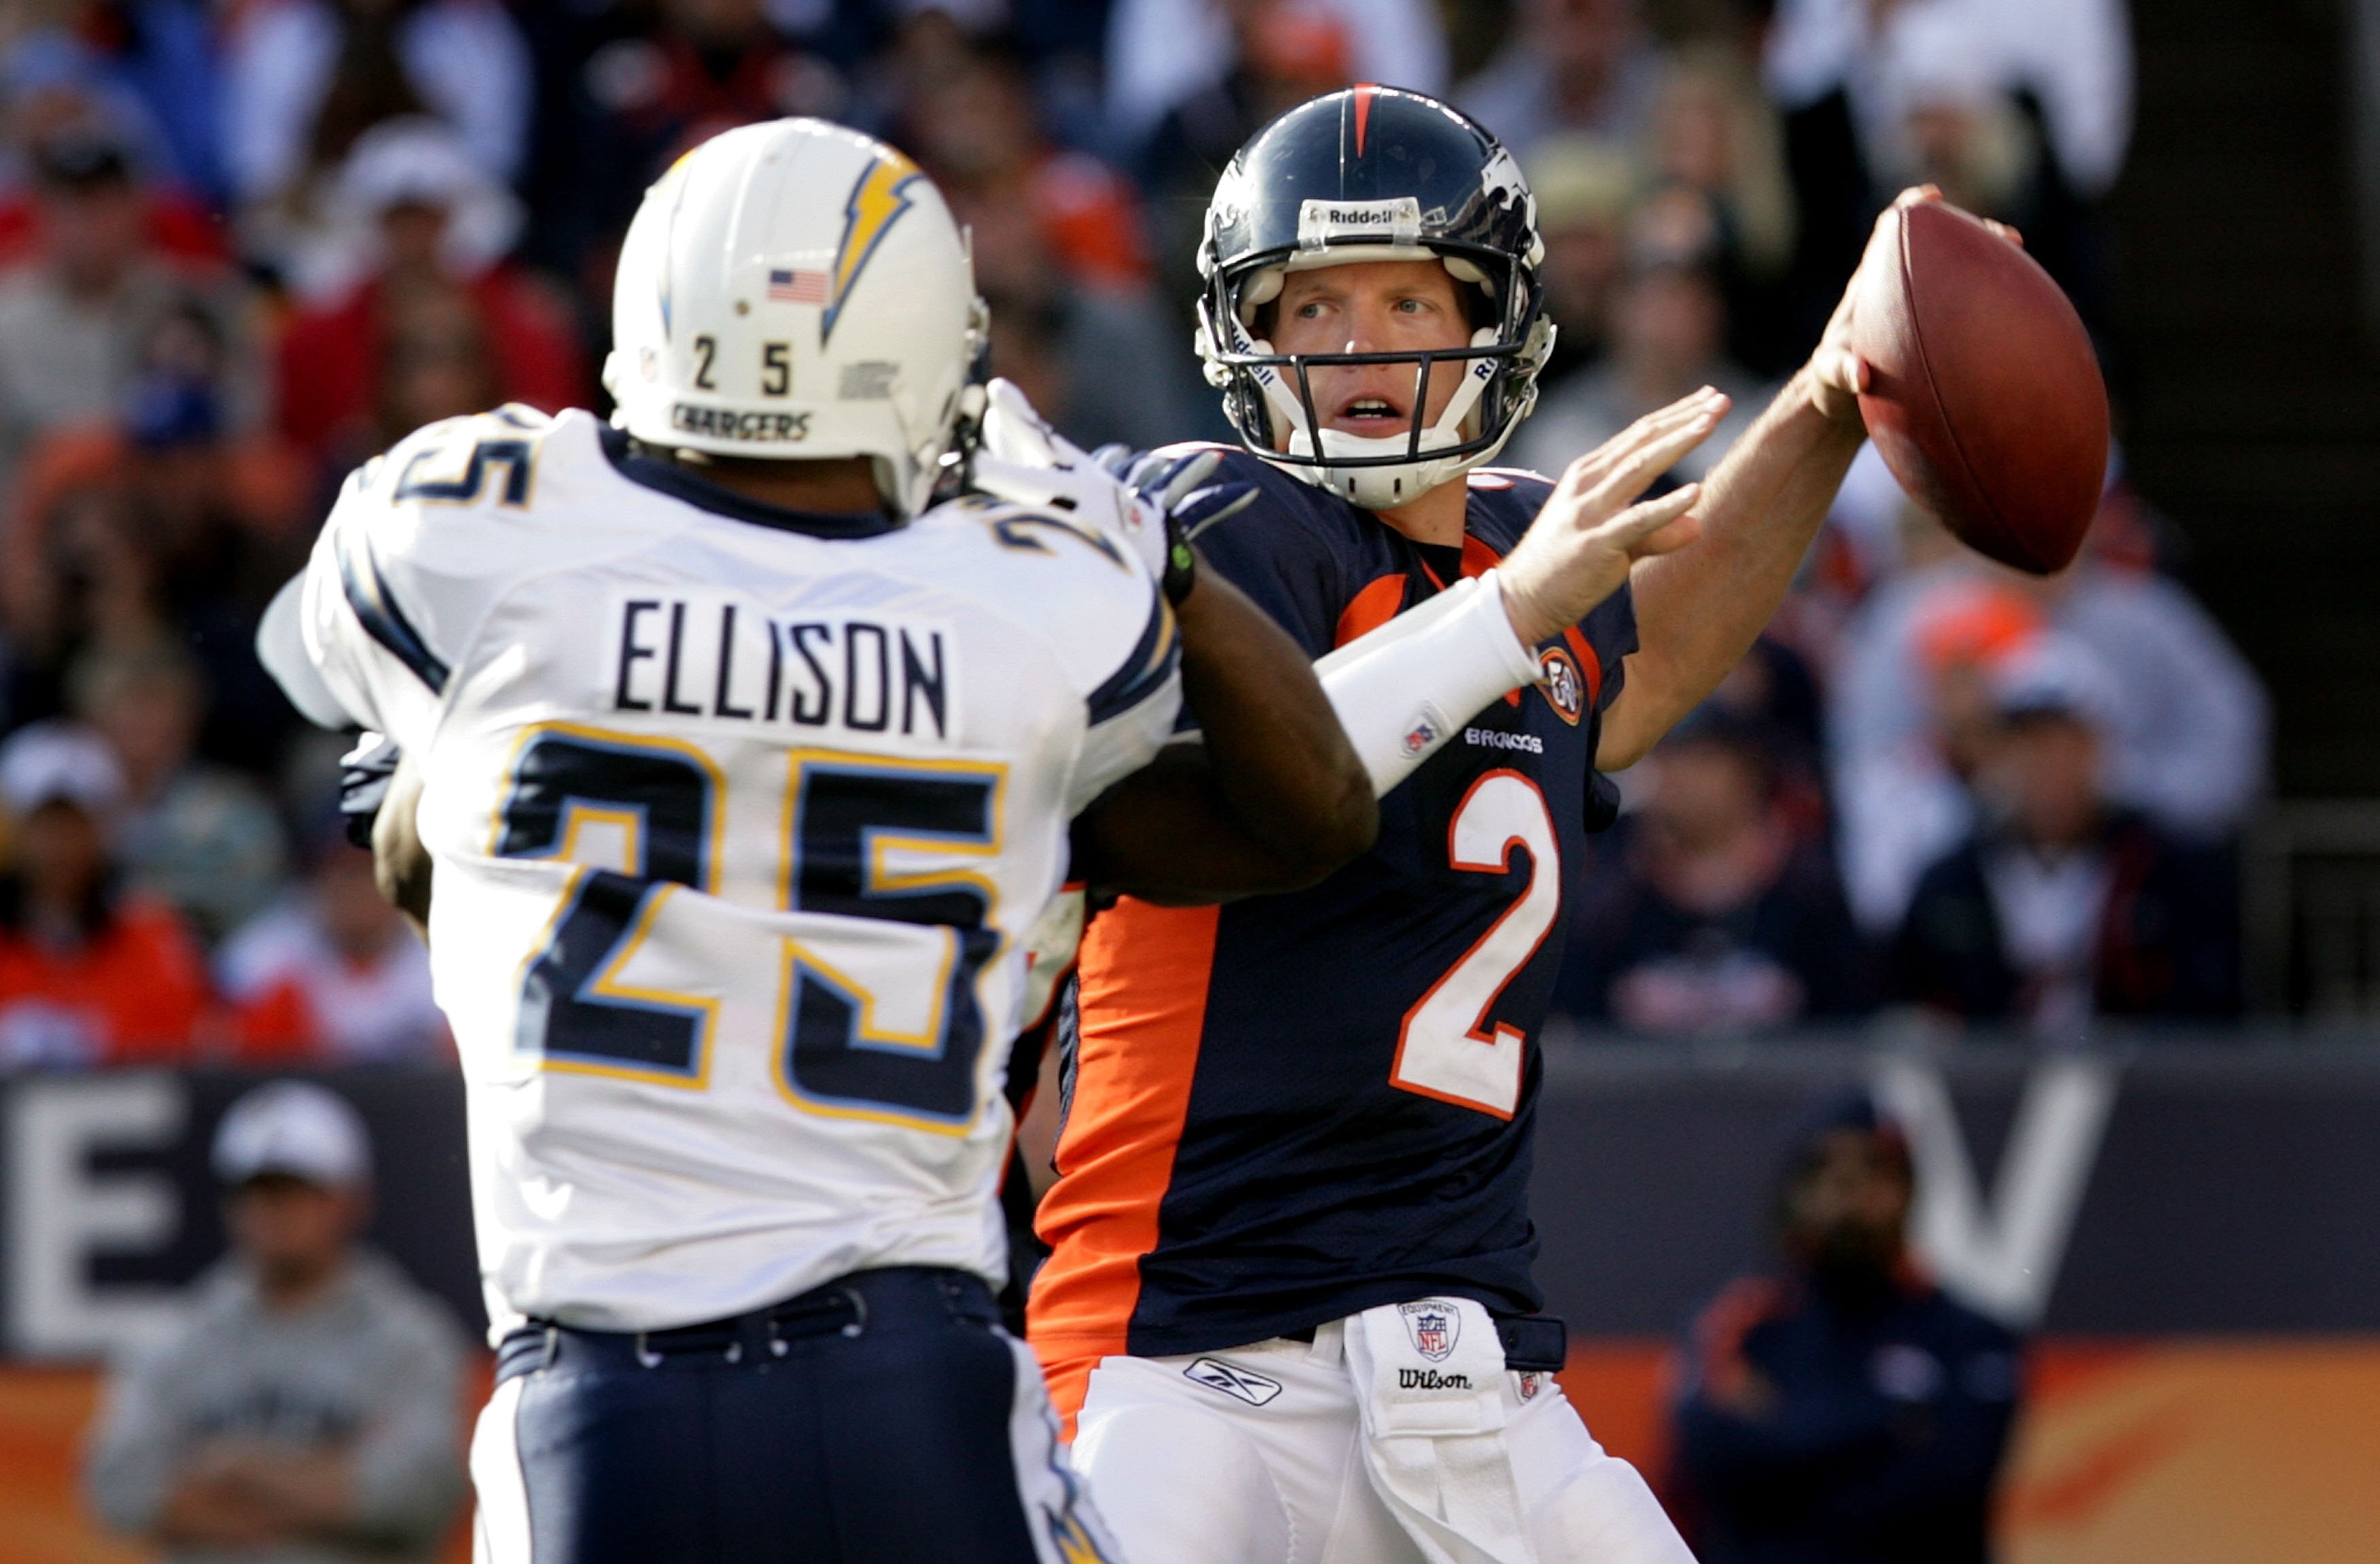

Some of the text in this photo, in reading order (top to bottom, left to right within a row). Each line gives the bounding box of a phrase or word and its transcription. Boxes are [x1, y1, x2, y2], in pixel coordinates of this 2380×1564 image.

[1329, 209, 1393, 224] Riddell
[672, 403, 813, 441] CHARGERS
[614, 600, 947, 740] ELLISON
[1465, 727, 1543, 754] BRONCOS
[486, 721, 1010, 1137] 25
[1389, 768, 1562, 1121] 2
[1418, 1332, 1447, 1352] NFL
[1399, 1368, 1469, 1389] Wilson
